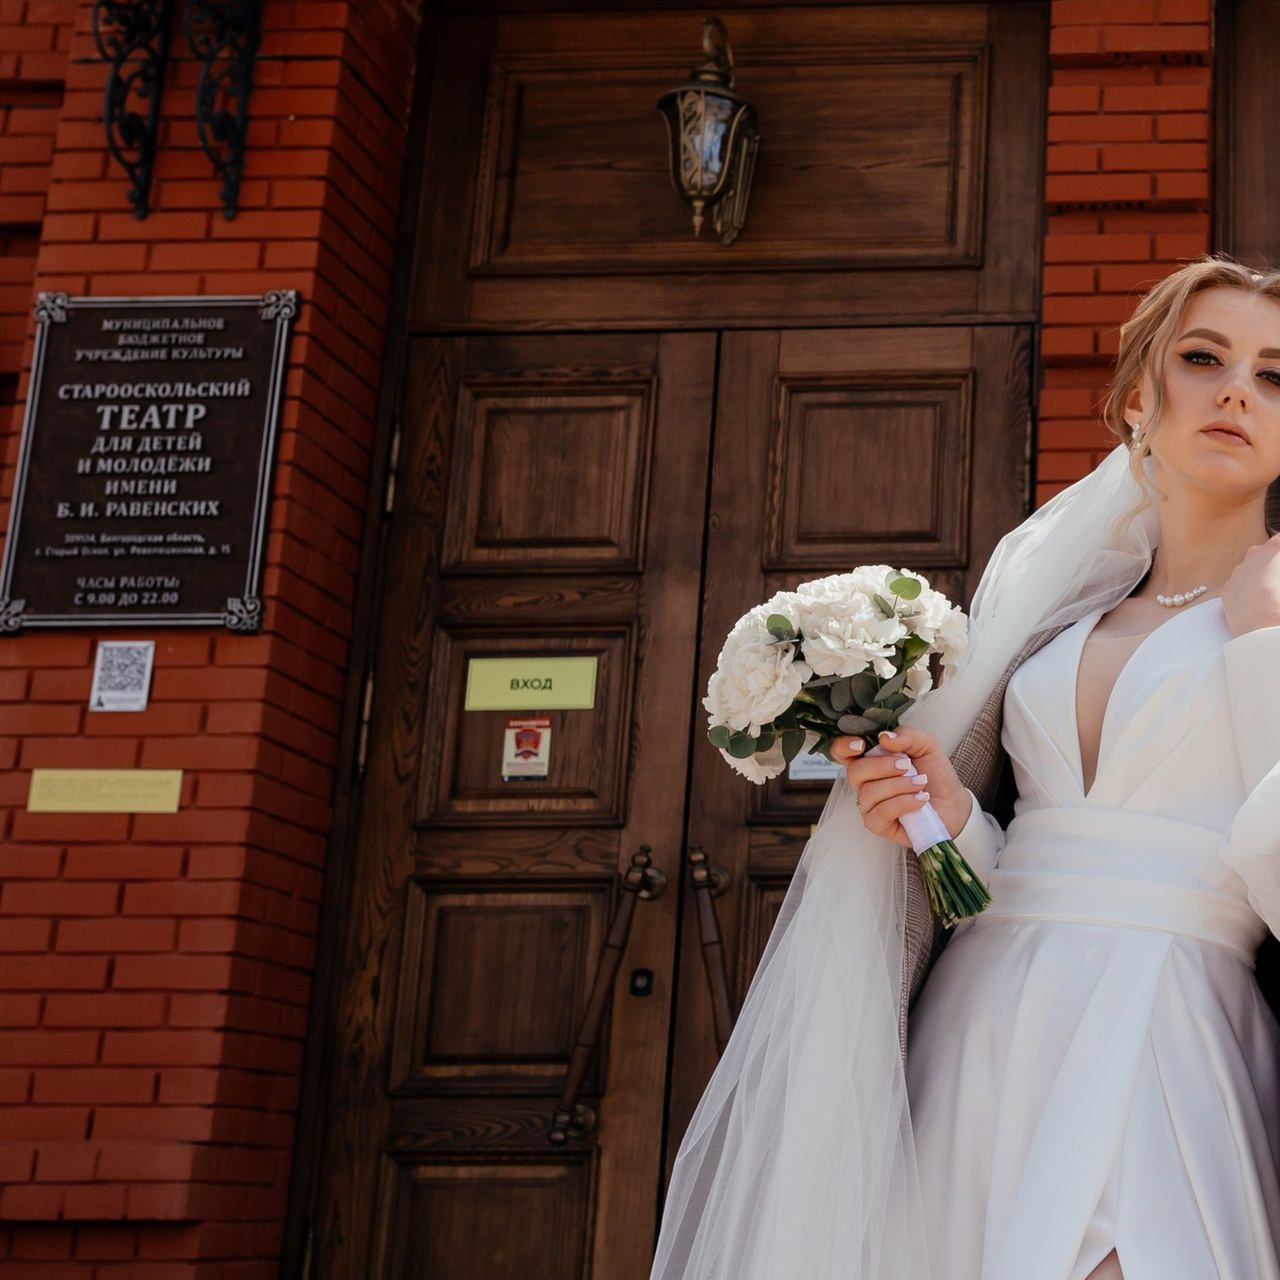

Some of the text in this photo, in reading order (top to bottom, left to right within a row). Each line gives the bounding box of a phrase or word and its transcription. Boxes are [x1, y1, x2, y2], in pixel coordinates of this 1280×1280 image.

[102, 318, 225, 332] МУНИЦИПАЛЬНОЕ
[118, 333, 204, 346] БЮДЖЕТНОЕ
[75, 347, 244, 362] УЧРЕЖДЕНИЕ КУЛЬТУРЫ
[58, 379, 251, 399] СТАРООСКОЛЬСКИЙ
[97, 404, 206, 430] ТЕАТР
[91, 434, 202, 453] ДЛЯ ДЕТЕЙ
[78, 455, 211, 475] И МОЛОДЁЖИ
[105, 480, 177, 495] ИМЕНИ
[57, 501, 220, 518] Б. И. РАВЕНСКИХ
[77, 577, 180, 588] ЧАСЫ РАБОТЫ:
[74, 592, 179, 606] С 9.00 ДО 22.00
[511, 678, 552, 690] ВХОД
